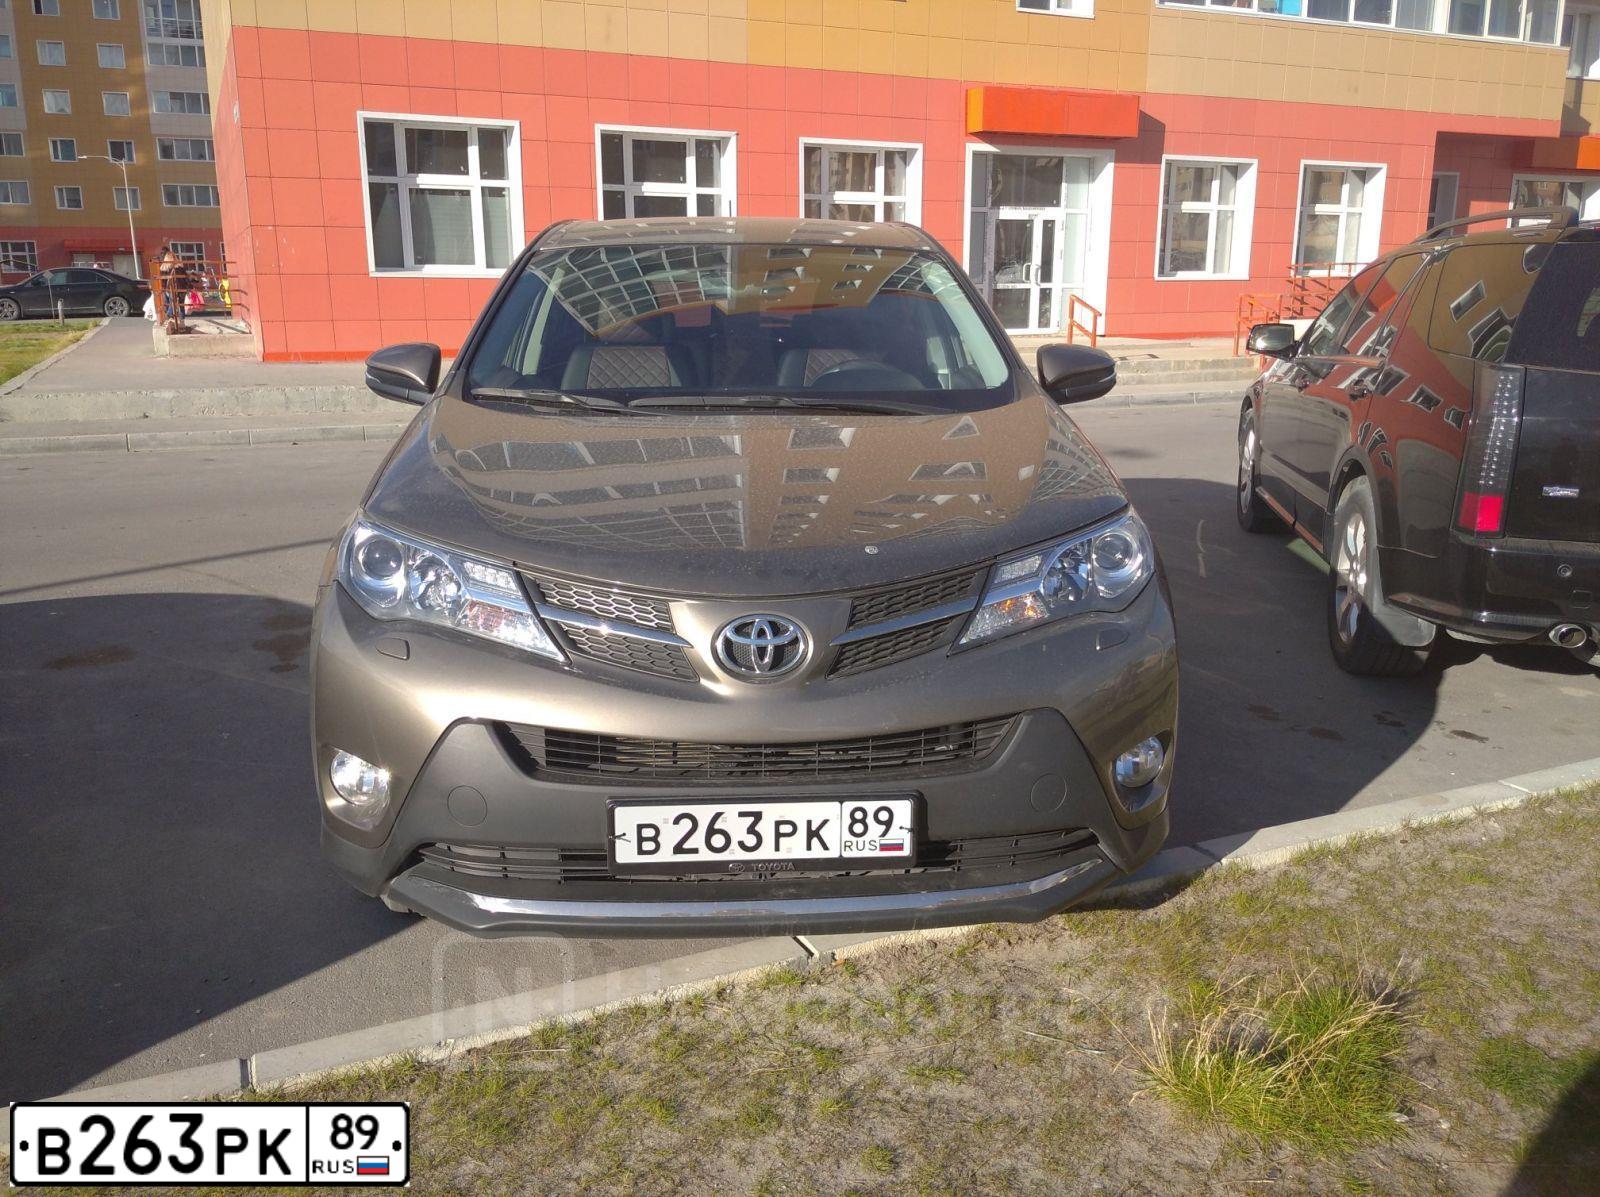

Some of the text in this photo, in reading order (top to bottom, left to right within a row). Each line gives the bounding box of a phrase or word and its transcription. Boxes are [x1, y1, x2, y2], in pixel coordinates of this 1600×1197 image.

[848, 806, 894, 838] 89
[844, 839, 878, 852] RUS
[751, 861, 796, 872] TOYOTA
